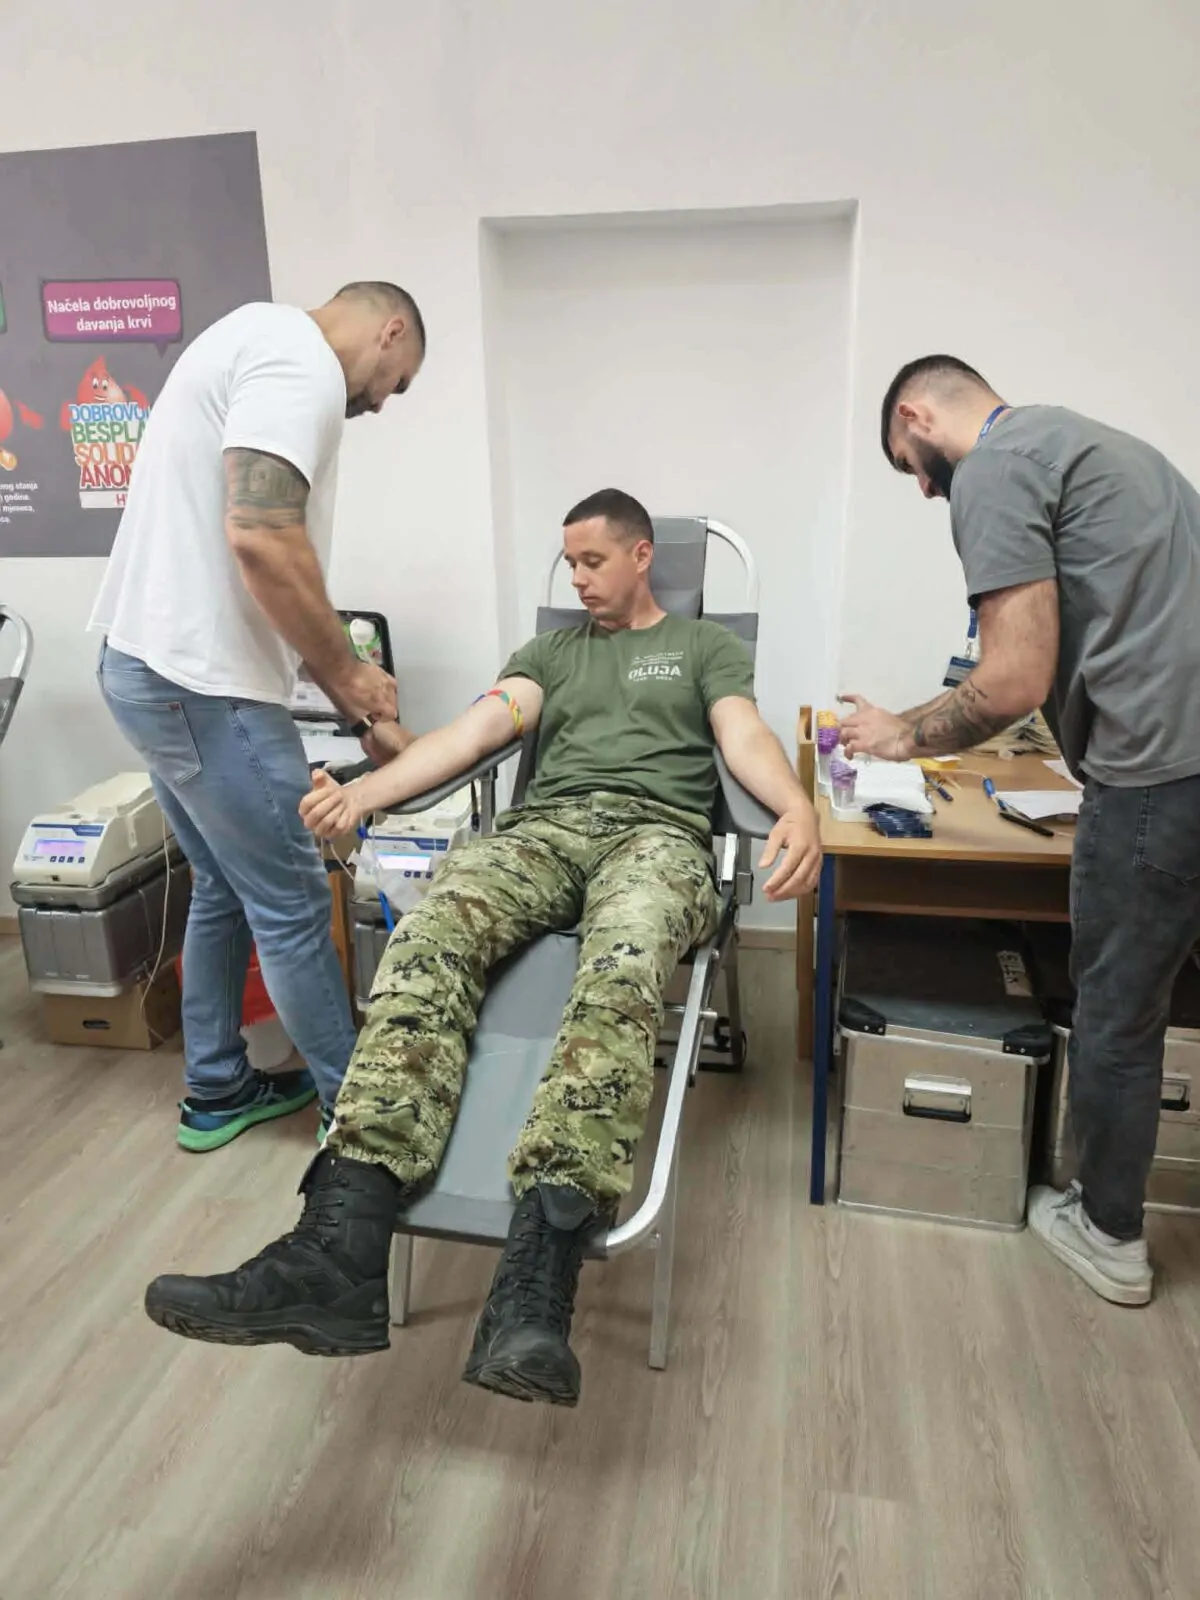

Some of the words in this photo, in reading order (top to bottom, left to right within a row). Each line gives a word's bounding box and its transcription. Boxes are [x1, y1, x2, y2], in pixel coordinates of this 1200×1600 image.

[47, 298, 90, 312] Načela
[93, 293, 176, 311] dobrovoljnog
[76, 316, 125, 333] davanja
[127, 314, 152, 329] krvi
[75, 442, 139, 464] SOLID
[628, 664, 681, 680] OLUJA
